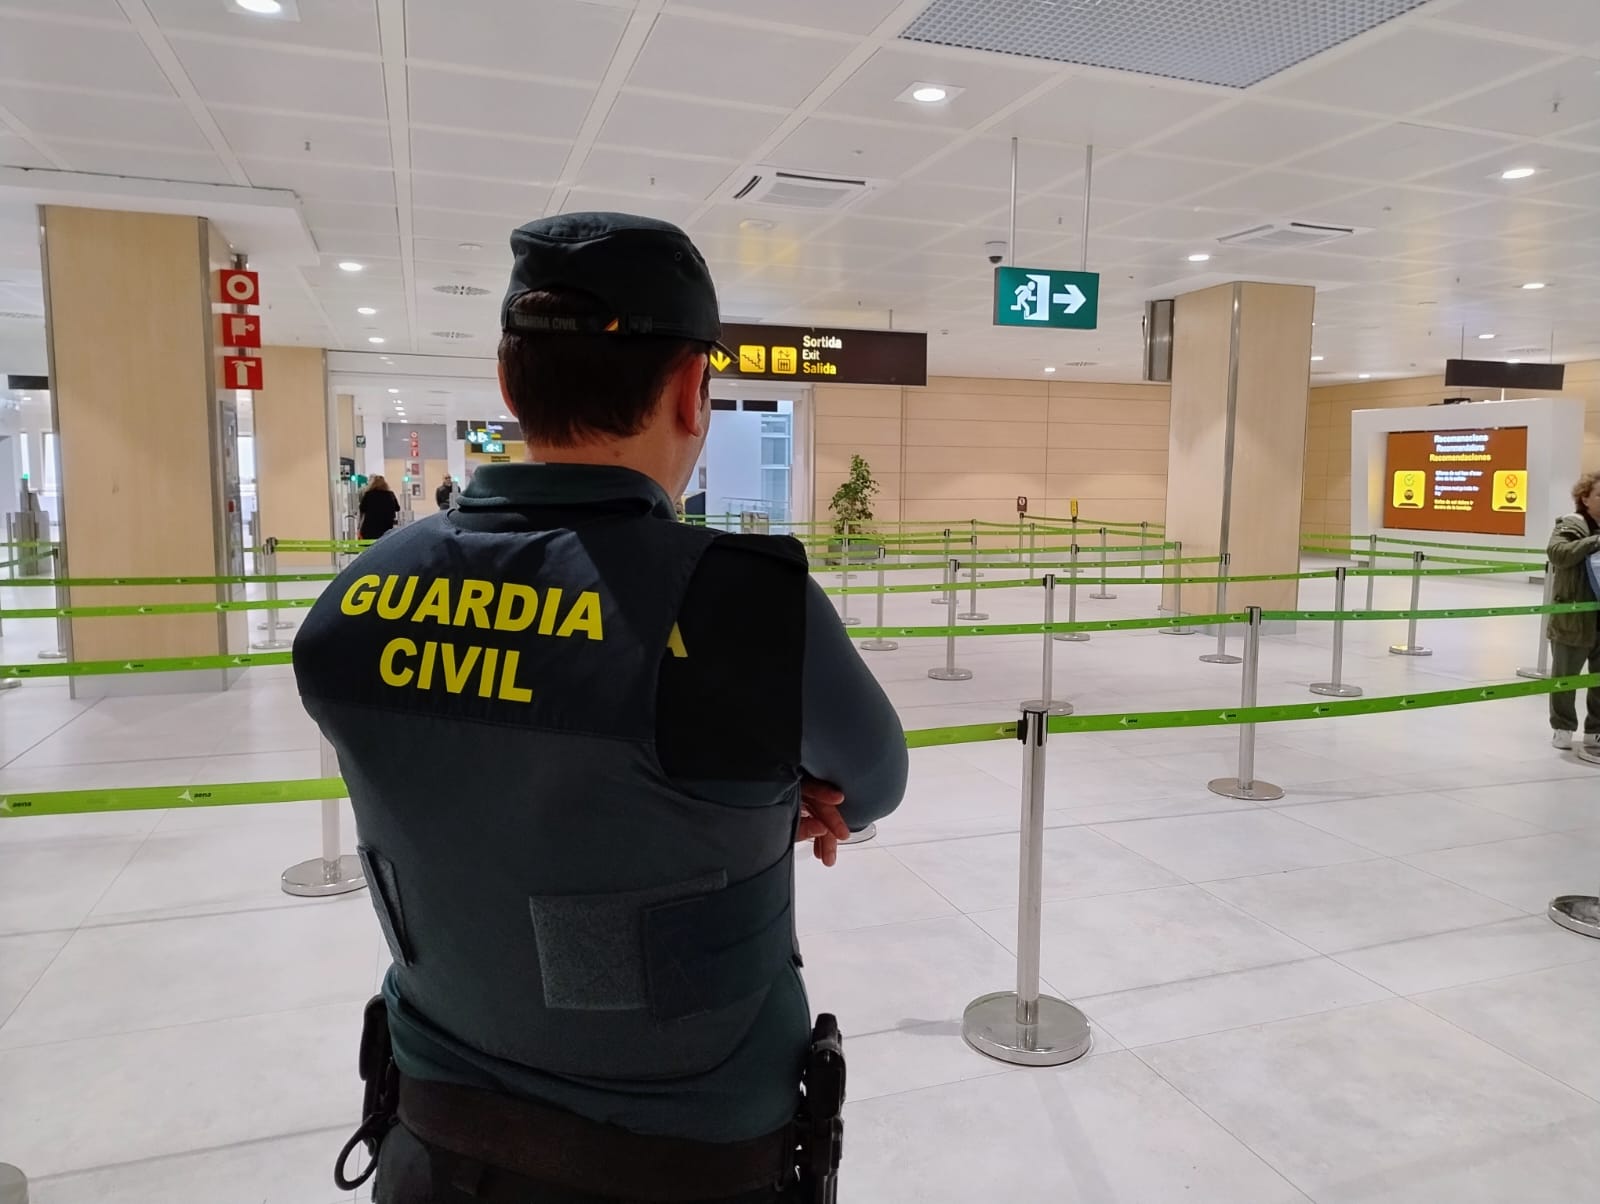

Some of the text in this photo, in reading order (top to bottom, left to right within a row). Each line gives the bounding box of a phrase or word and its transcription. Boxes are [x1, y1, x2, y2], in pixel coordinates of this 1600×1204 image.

[802, 335, 843, 349] Sortida
[802, 349, 821, 361] Exit
[802, 362, 837, 375] Salida
[340, 574, 604, 641] GUARDIA
[379, 637, 533, 703] CIVIL
[194, 791, 212, 799] aena
